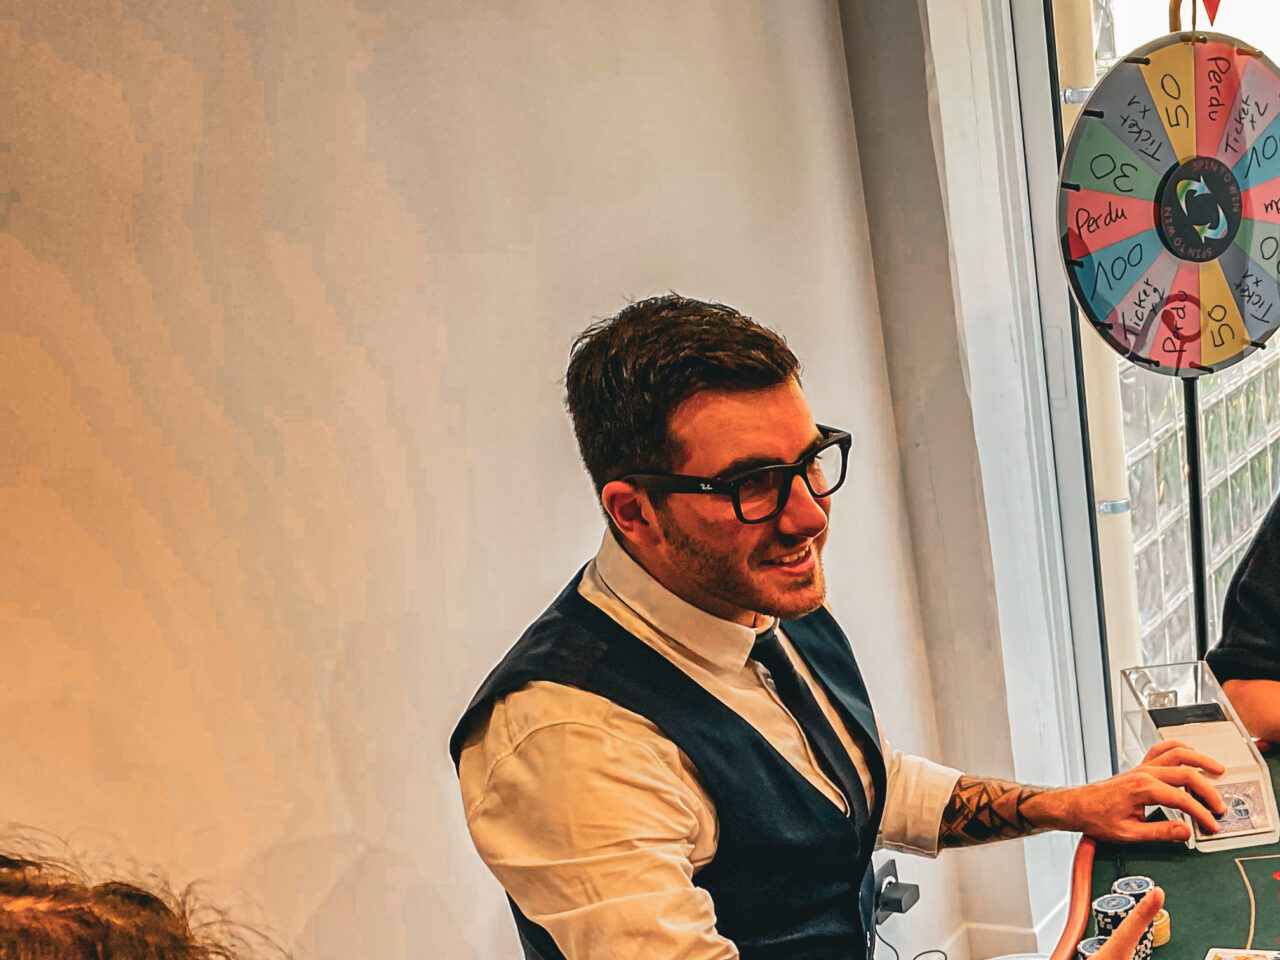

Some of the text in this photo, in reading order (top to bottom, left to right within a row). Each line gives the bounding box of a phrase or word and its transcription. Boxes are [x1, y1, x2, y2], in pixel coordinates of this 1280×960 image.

[1160, 73, 1189, 128] 50
[1207, 56, 1231, 121] Perdu
[1090, 153, 1138, 193] 30
[1075, 201, 1128, 239] Perdu
[1090, 243, 1143, 302] 100
[1207, 304, 1235, 348] 50
